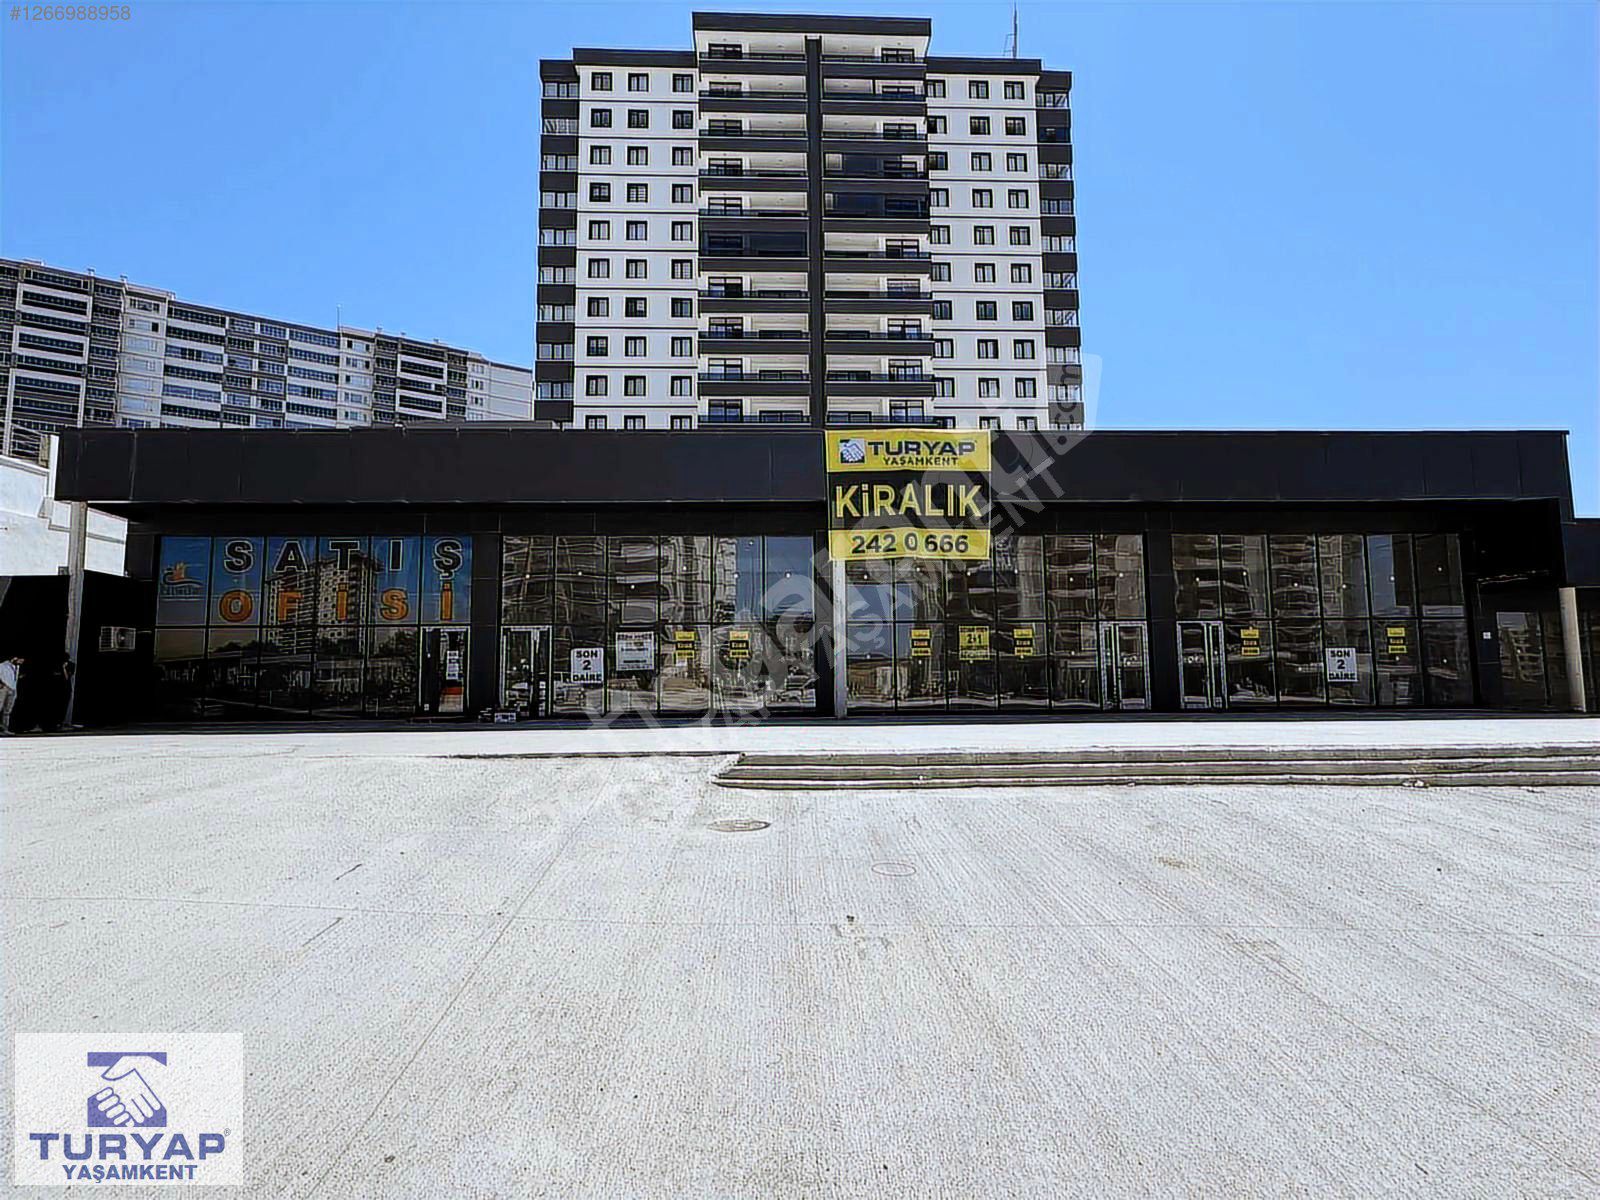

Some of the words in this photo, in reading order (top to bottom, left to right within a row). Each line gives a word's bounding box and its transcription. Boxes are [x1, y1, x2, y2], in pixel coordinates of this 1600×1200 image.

[867, 440, 975, 456] TURYAP
[851, 534, 896, 554] 242
[904, 532, 919, 551] 0
[924, 534, 969, 554] 666
[223, 537, 464, 581] SATIŞ
[576, 650, 598, 659] SON
[1329, 649, 1351, 658] SON
[583, 660, 592, 670] 2
[1337, 659, 1346, 670] 2
